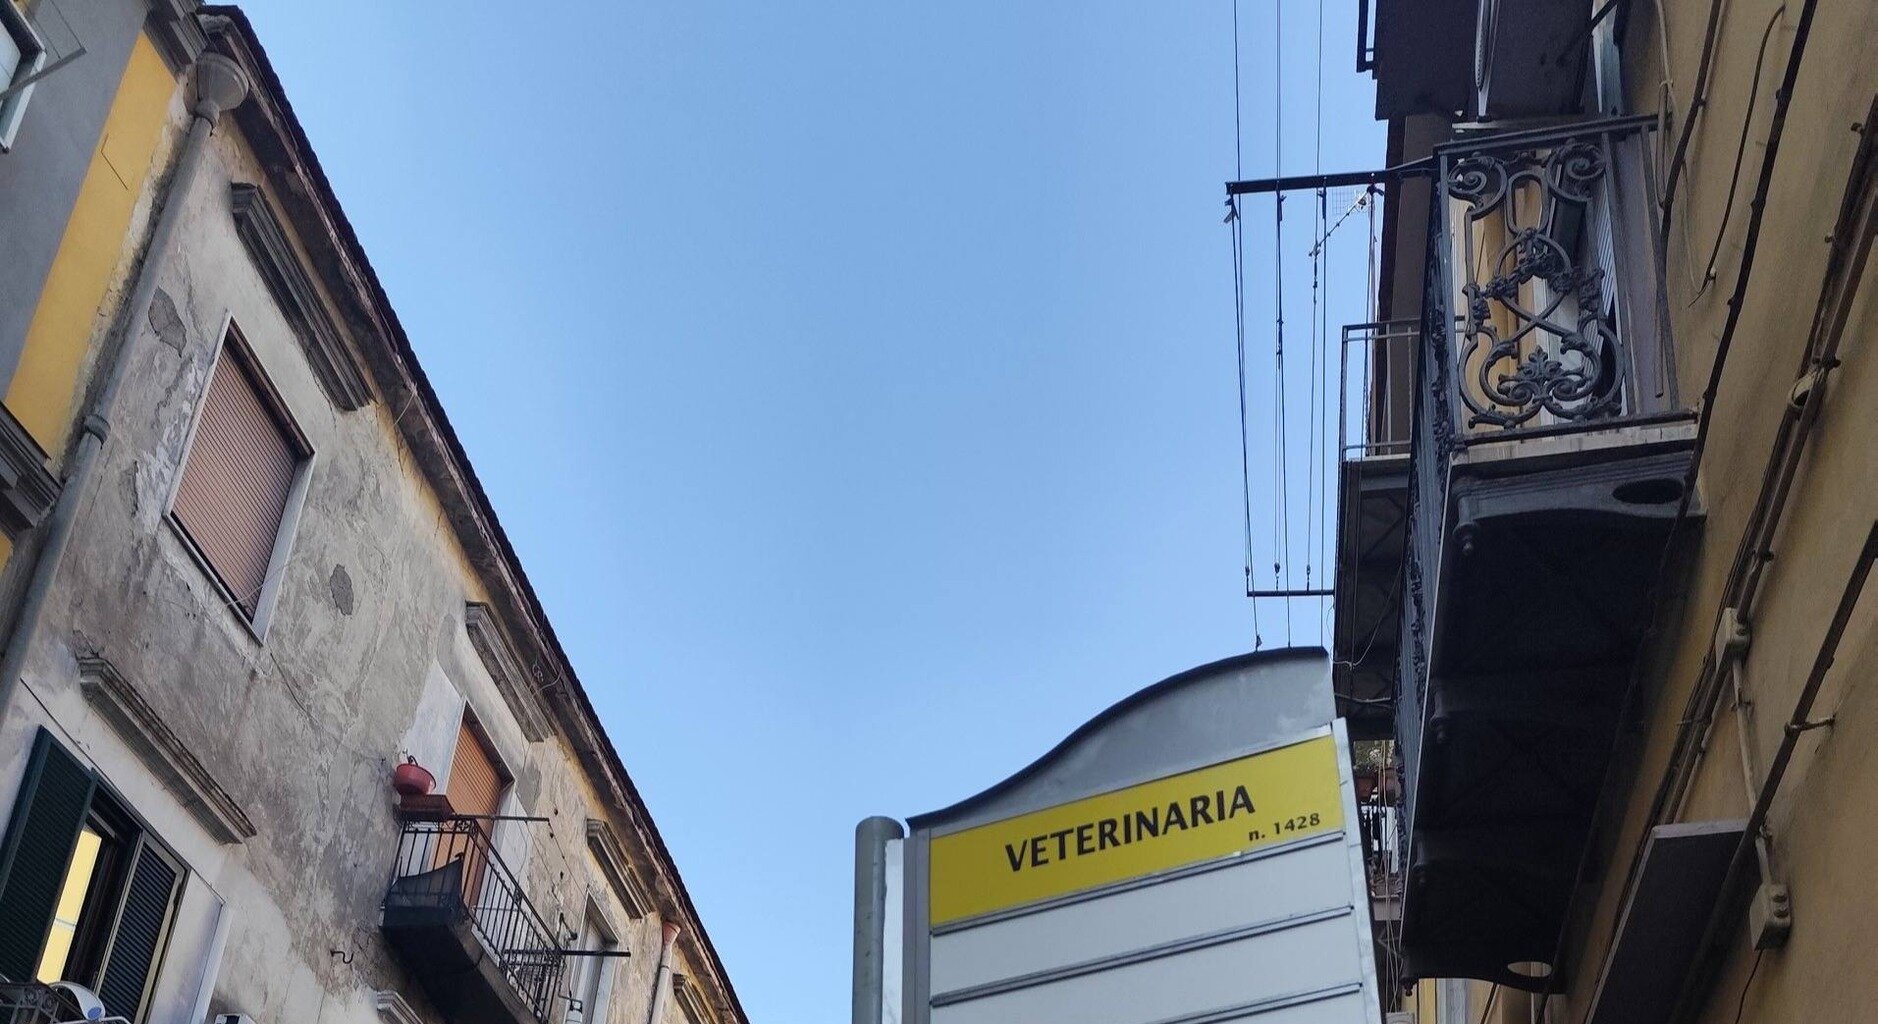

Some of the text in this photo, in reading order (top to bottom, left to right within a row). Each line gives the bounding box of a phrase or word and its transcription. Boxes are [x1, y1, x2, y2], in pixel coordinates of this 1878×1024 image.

[1004, 785, 1256, 873] VETERINARIA
[1248, 812, 1321, 842] n. 1428
